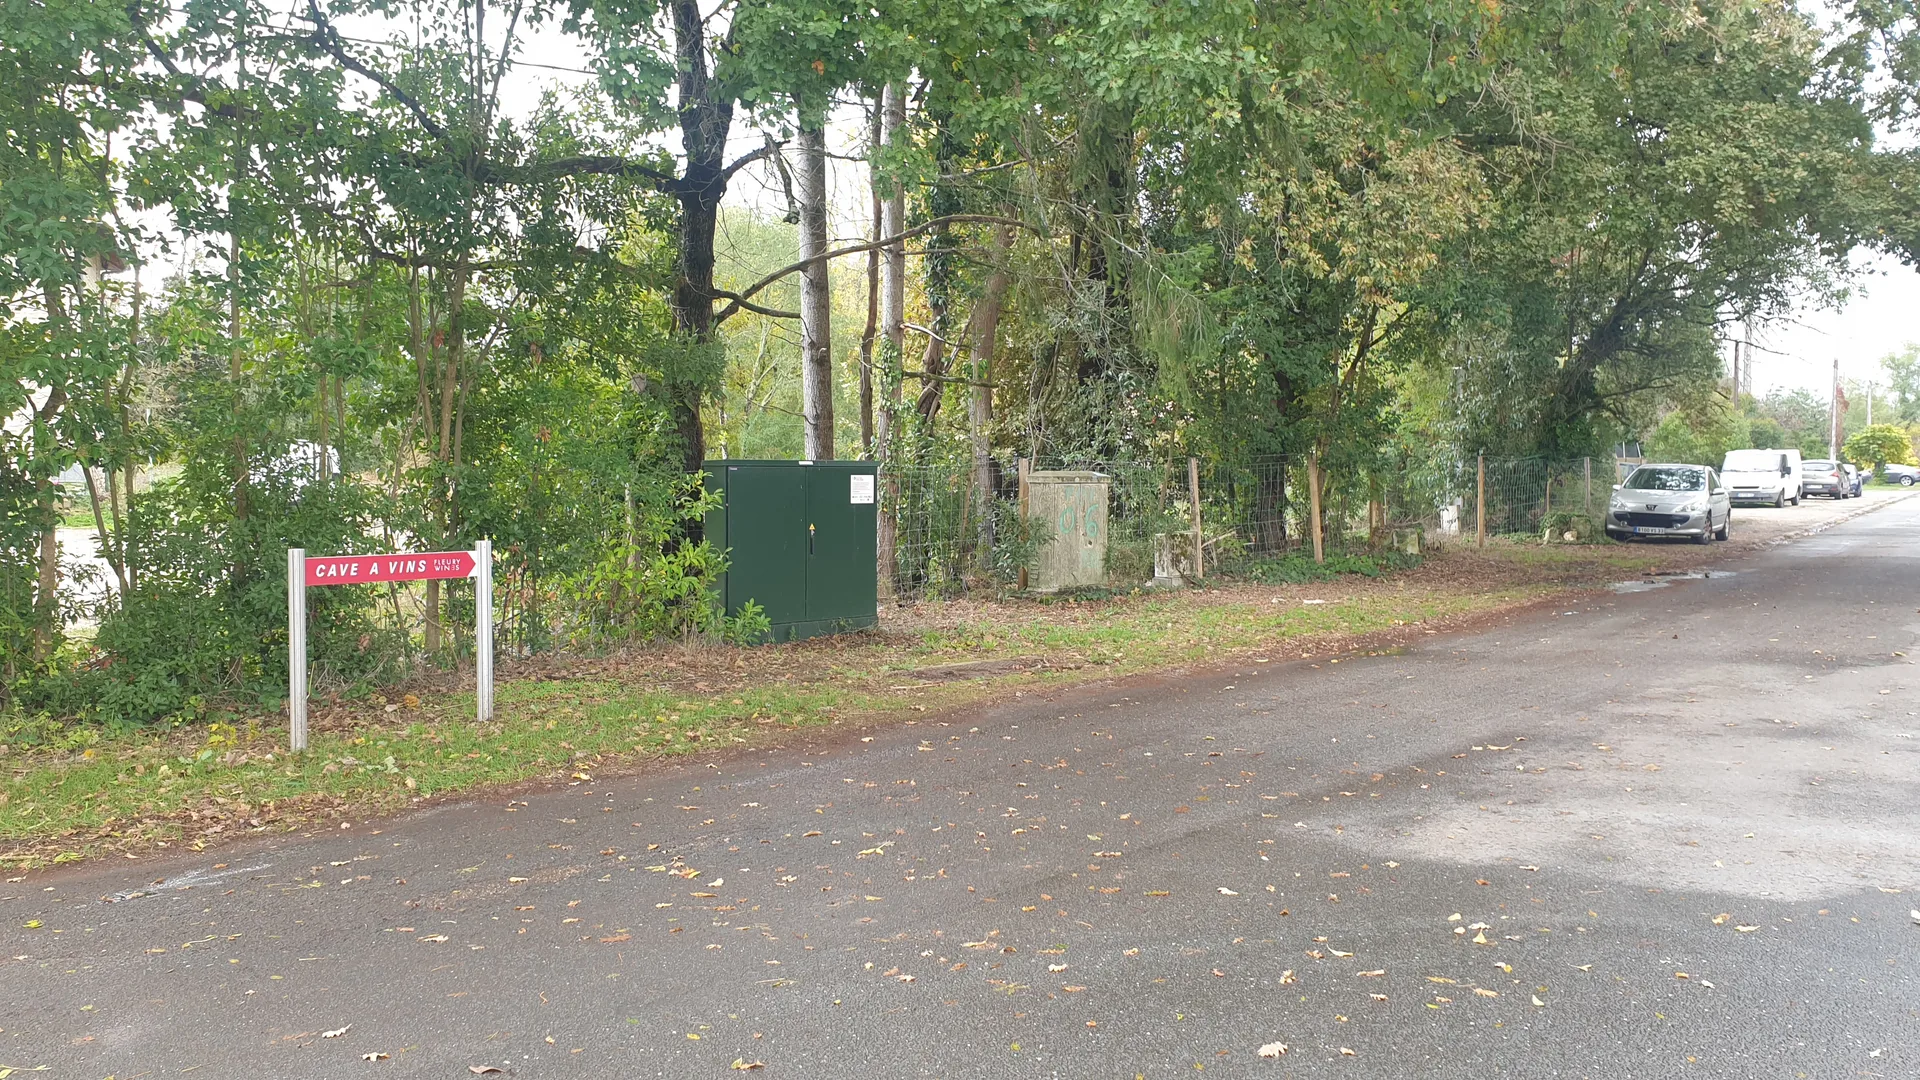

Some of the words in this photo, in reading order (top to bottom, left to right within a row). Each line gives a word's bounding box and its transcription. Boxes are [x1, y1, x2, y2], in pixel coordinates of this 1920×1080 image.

[315, 563, 358, 577] CAVE
[369, 562, 379, 576] A
[388, 560, 427, 574] VINS
